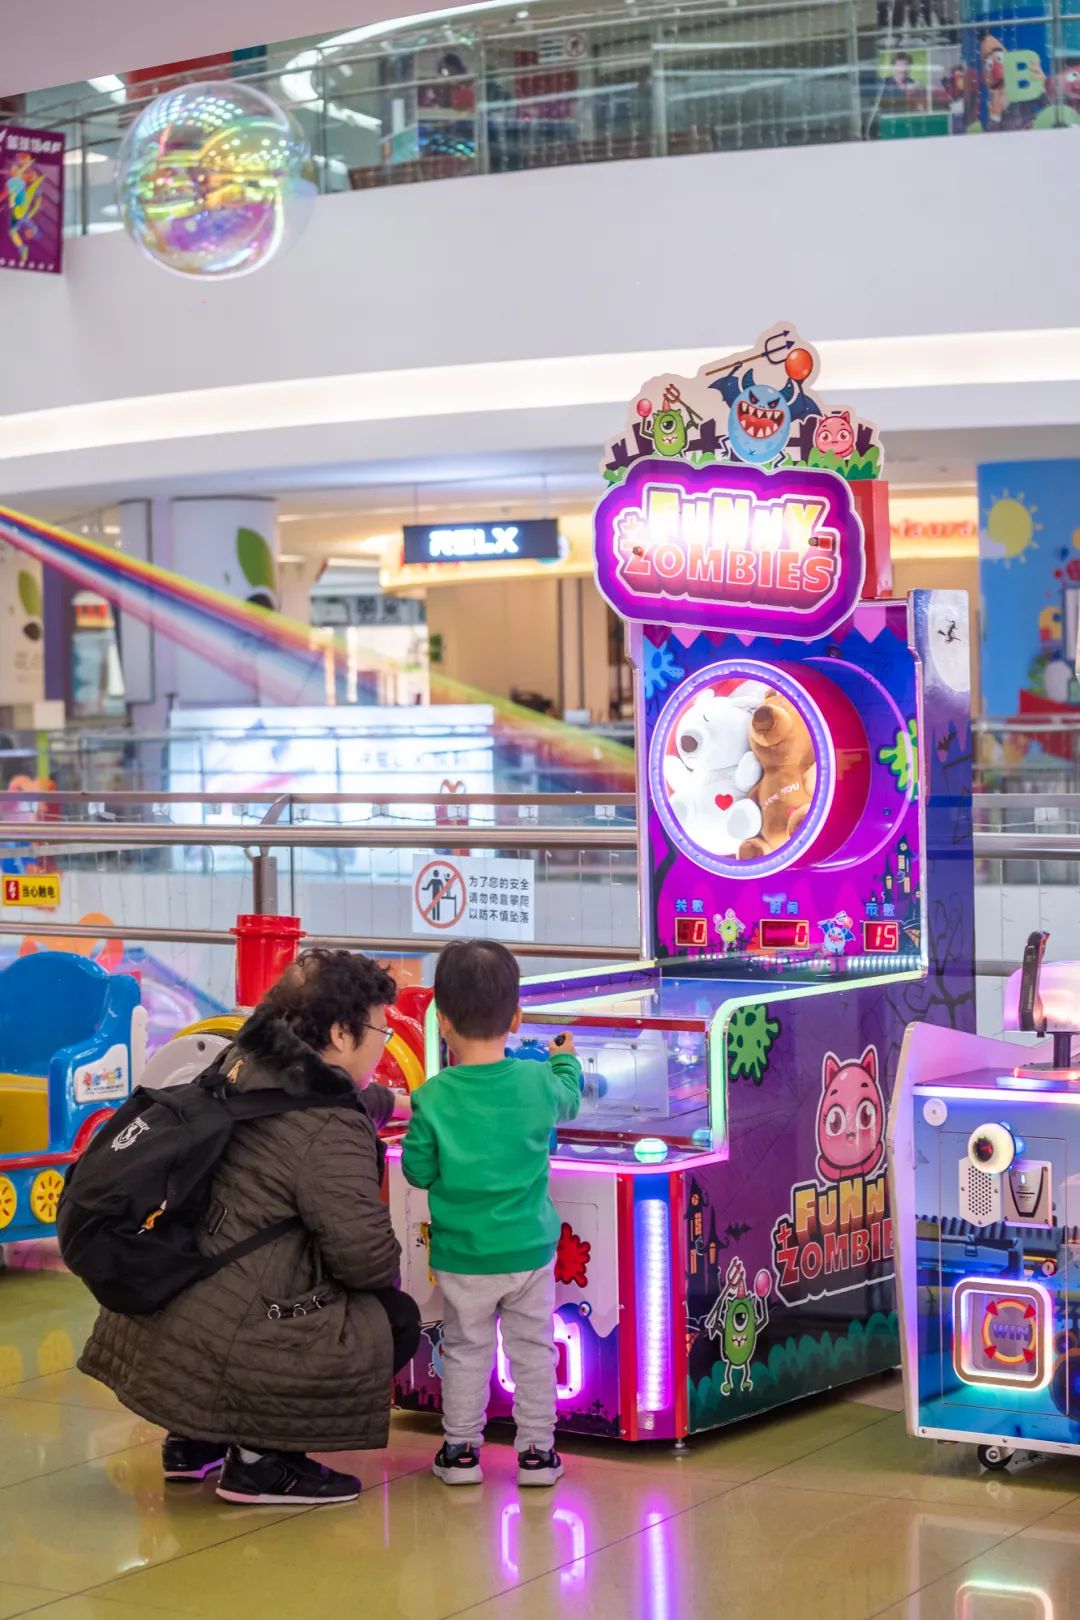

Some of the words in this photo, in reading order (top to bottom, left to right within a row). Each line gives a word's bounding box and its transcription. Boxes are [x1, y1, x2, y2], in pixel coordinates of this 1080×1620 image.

[1003, 50, 1045, 102] B
[429, 527, 519, 556] RELX
[621, 538, 834, 592] ZOMBIES
[22, 885, 56, 898] 当心触电
[468, 876, 529, 890] 为了您的安全
[468, 893, 529, 907] 请勿倚靠攀爬
[769, 900, 799, 915] 时间
[468, 909, 529, 923] 以防不慎坠落
[693, 921, 706, 943] 0
[794, 923, 808, 946] 0
[875, 925, 896, 948] 15
[795, 1177, 885, 1233] FUNN
[776, 1218, 895, 1287] ZOMBIE
[991, 1323, 1031, 1342] WIN
